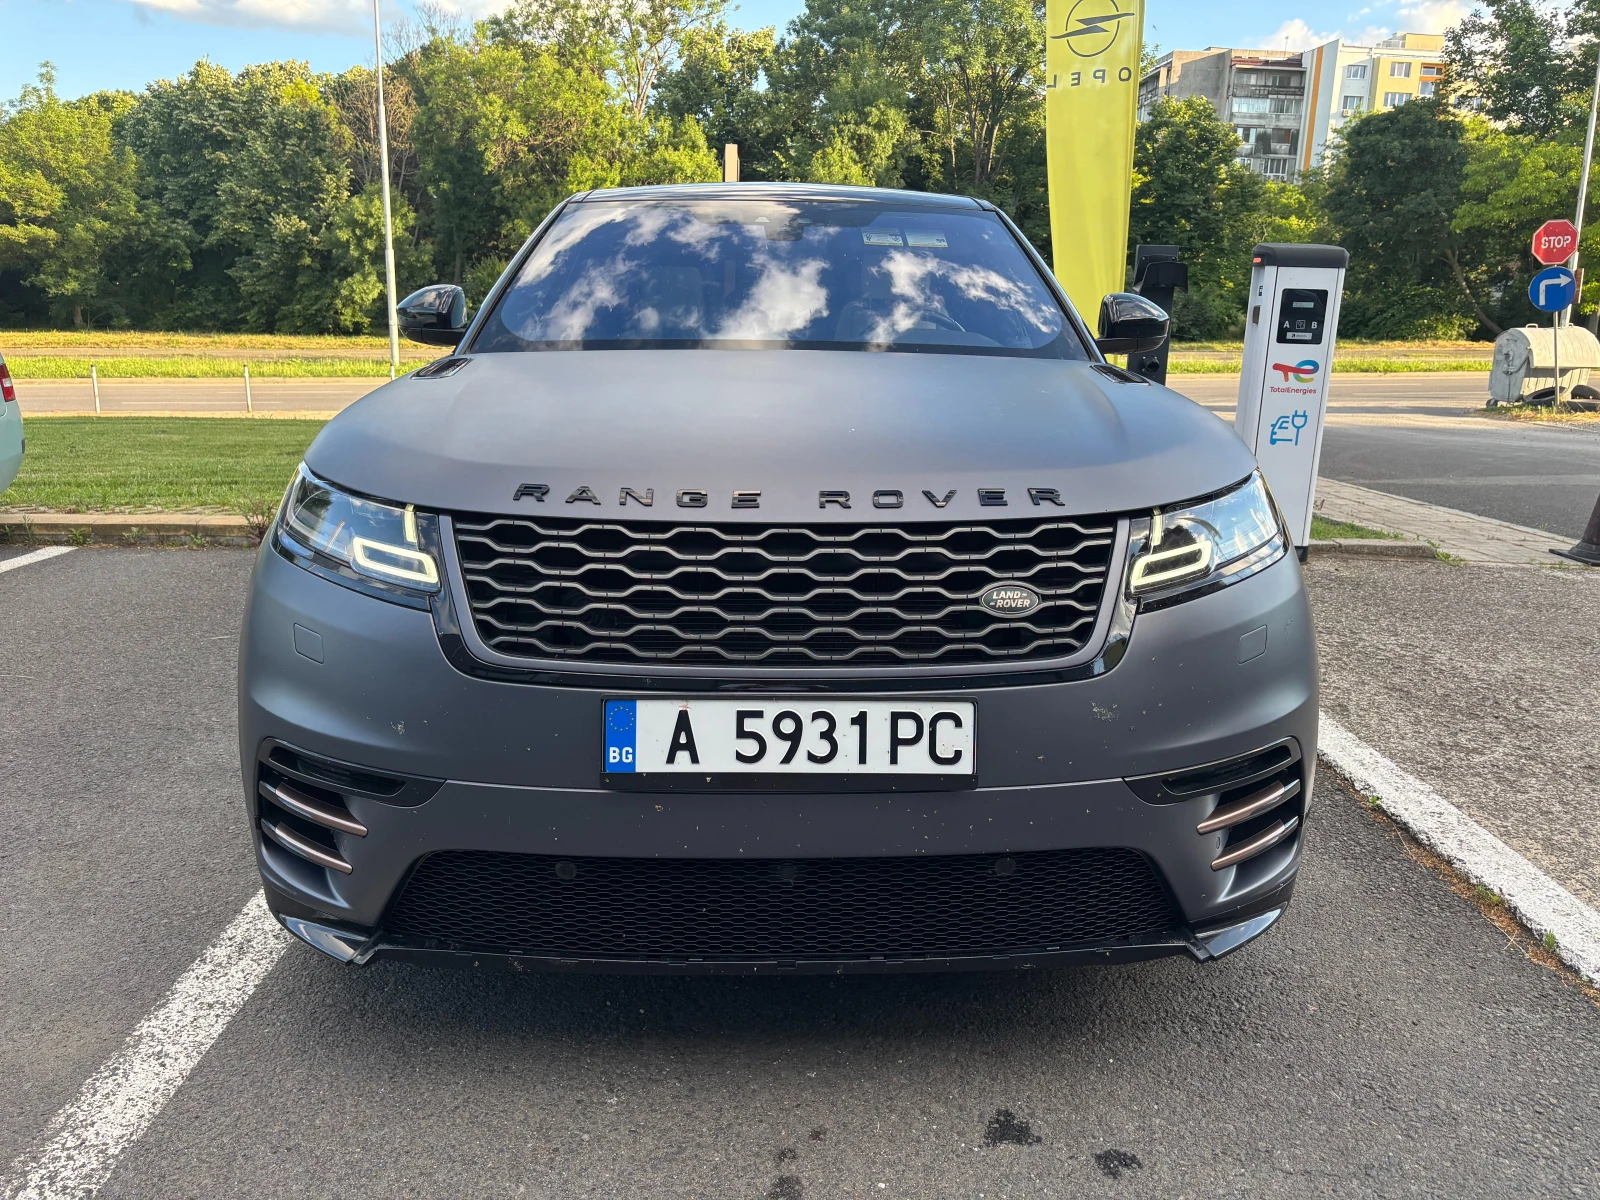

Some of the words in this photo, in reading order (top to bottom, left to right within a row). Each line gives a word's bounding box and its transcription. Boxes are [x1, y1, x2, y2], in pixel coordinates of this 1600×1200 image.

[1541, 235, 1571, 249] STOP
[1283, 320, 1290, 328] A
[1311, 321, 1318, 329] B
[1269, 386, 1317, 396] TotalEnergies
[512, 483, 762, 509] RANGE
[818, 487, 1066, 508] ROVER
[609, 747, 633, 763] BG
